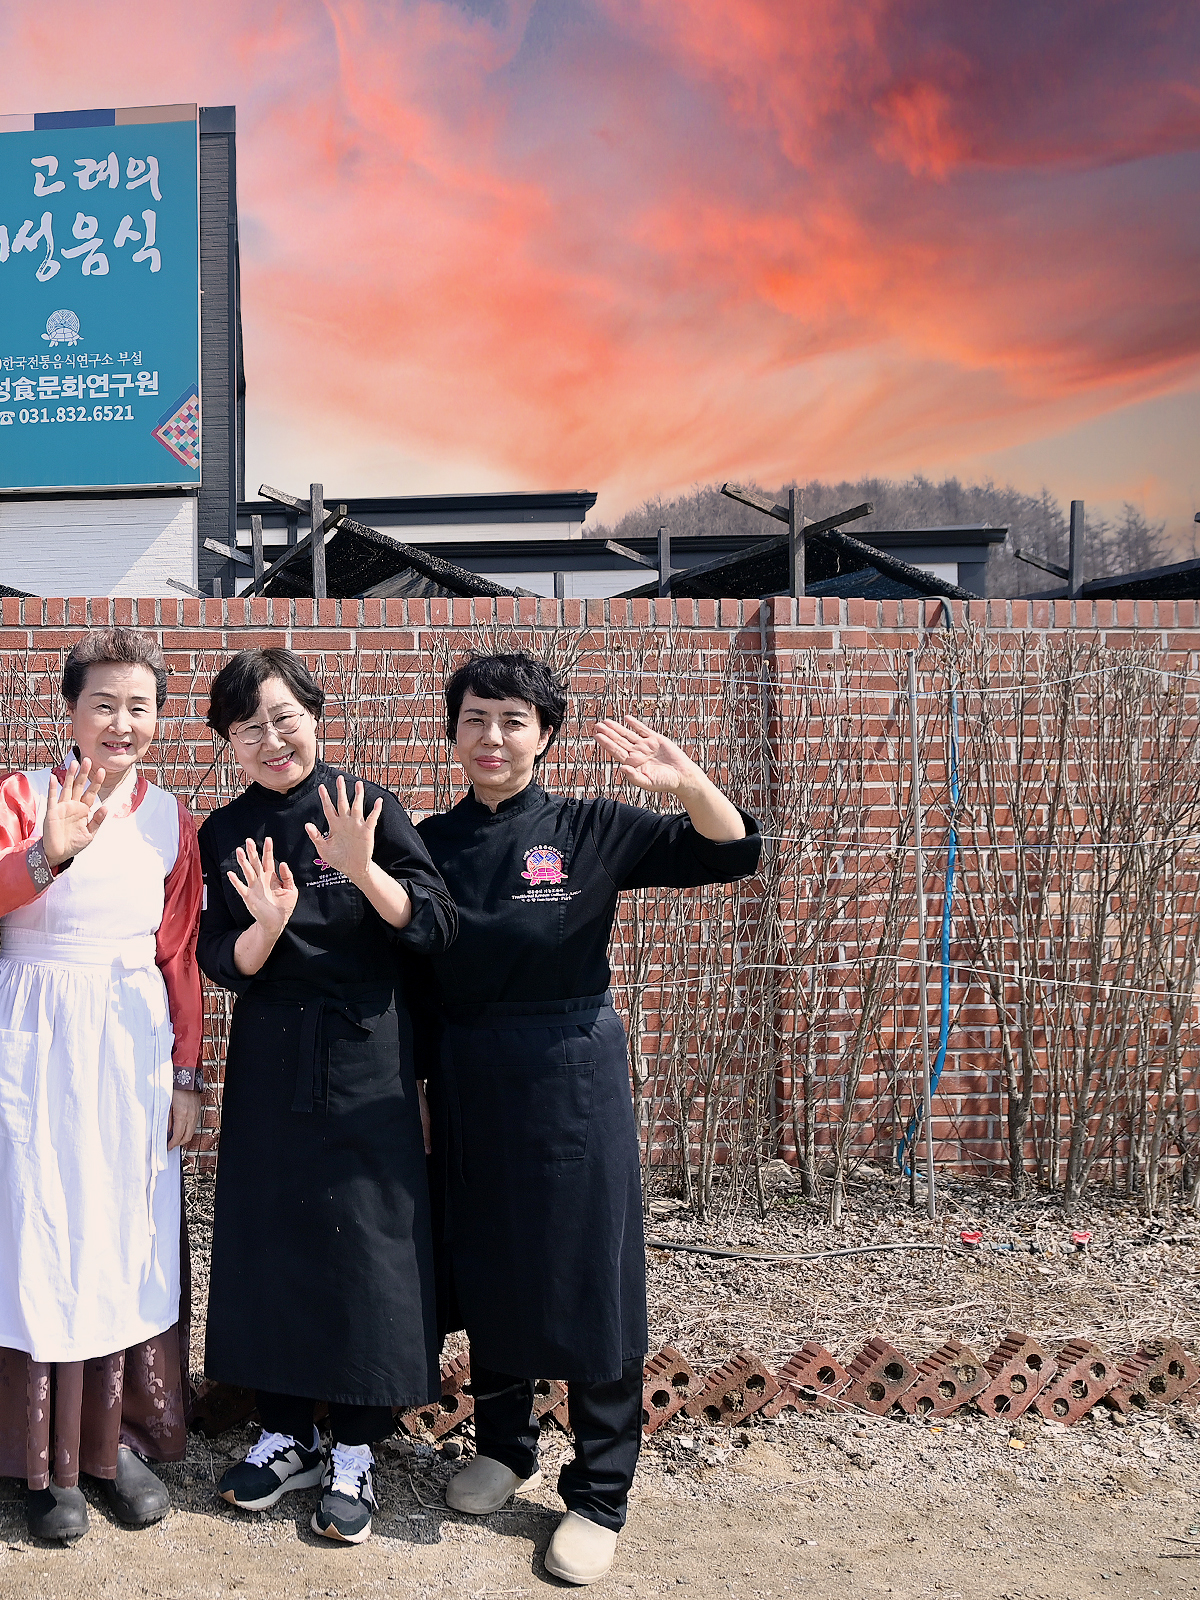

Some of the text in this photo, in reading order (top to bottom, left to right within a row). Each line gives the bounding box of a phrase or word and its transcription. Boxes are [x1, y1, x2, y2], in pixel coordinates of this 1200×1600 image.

[30, 151, 163, 202] 고려의
[117, 350, 143, 367] 부설
[18, 404, 135, 424] 031.832.6521
